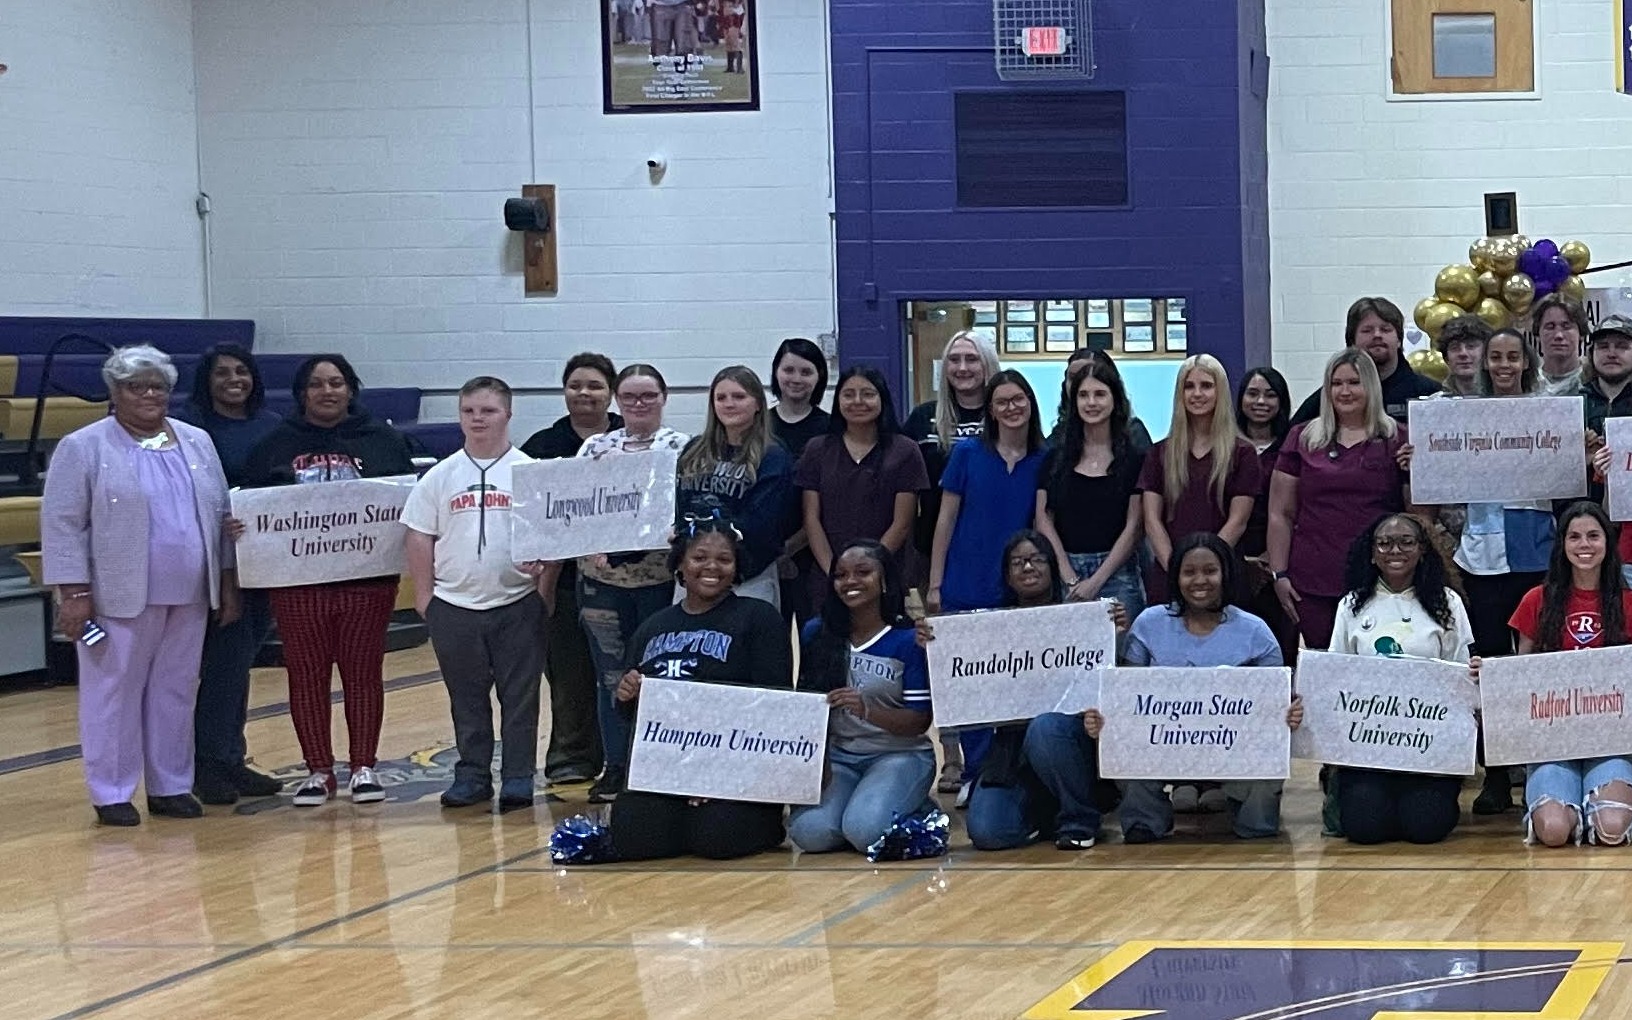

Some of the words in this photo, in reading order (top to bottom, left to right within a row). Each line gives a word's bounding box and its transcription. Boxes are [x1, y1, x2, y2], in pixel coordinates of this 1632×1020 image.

[451, 494, 475, 511] PAPA
[478, 493, 510, 508] OHN
[546, 487, 597, 527] Longwood
[599, 483, 643, 518] University
[256, 508, 358, 534] Washington
[291, 532, 377, 557] University
[1577, 616, 1594, 632] R
[853, 656, 896, 681] PTON
[951, 650, 1034, 678] Randolph
[1041, 646, 1104, 675] College
[1133, 694, 1203, 721] Morgan
[1209, 694, 1253, 716] State
[1333, 690, 1401, 720] Norfolk
[1404, 697, 1448, 721] State
[1530, 690, 1571, 726] Radford
[1574, 685, 1625, 719] University
[642, 721, 722, 752] Hampton
[728, 728, 819, 762] University
[1149, 723, 1238, 751] University
[1348, 721, 1434, 754] University
